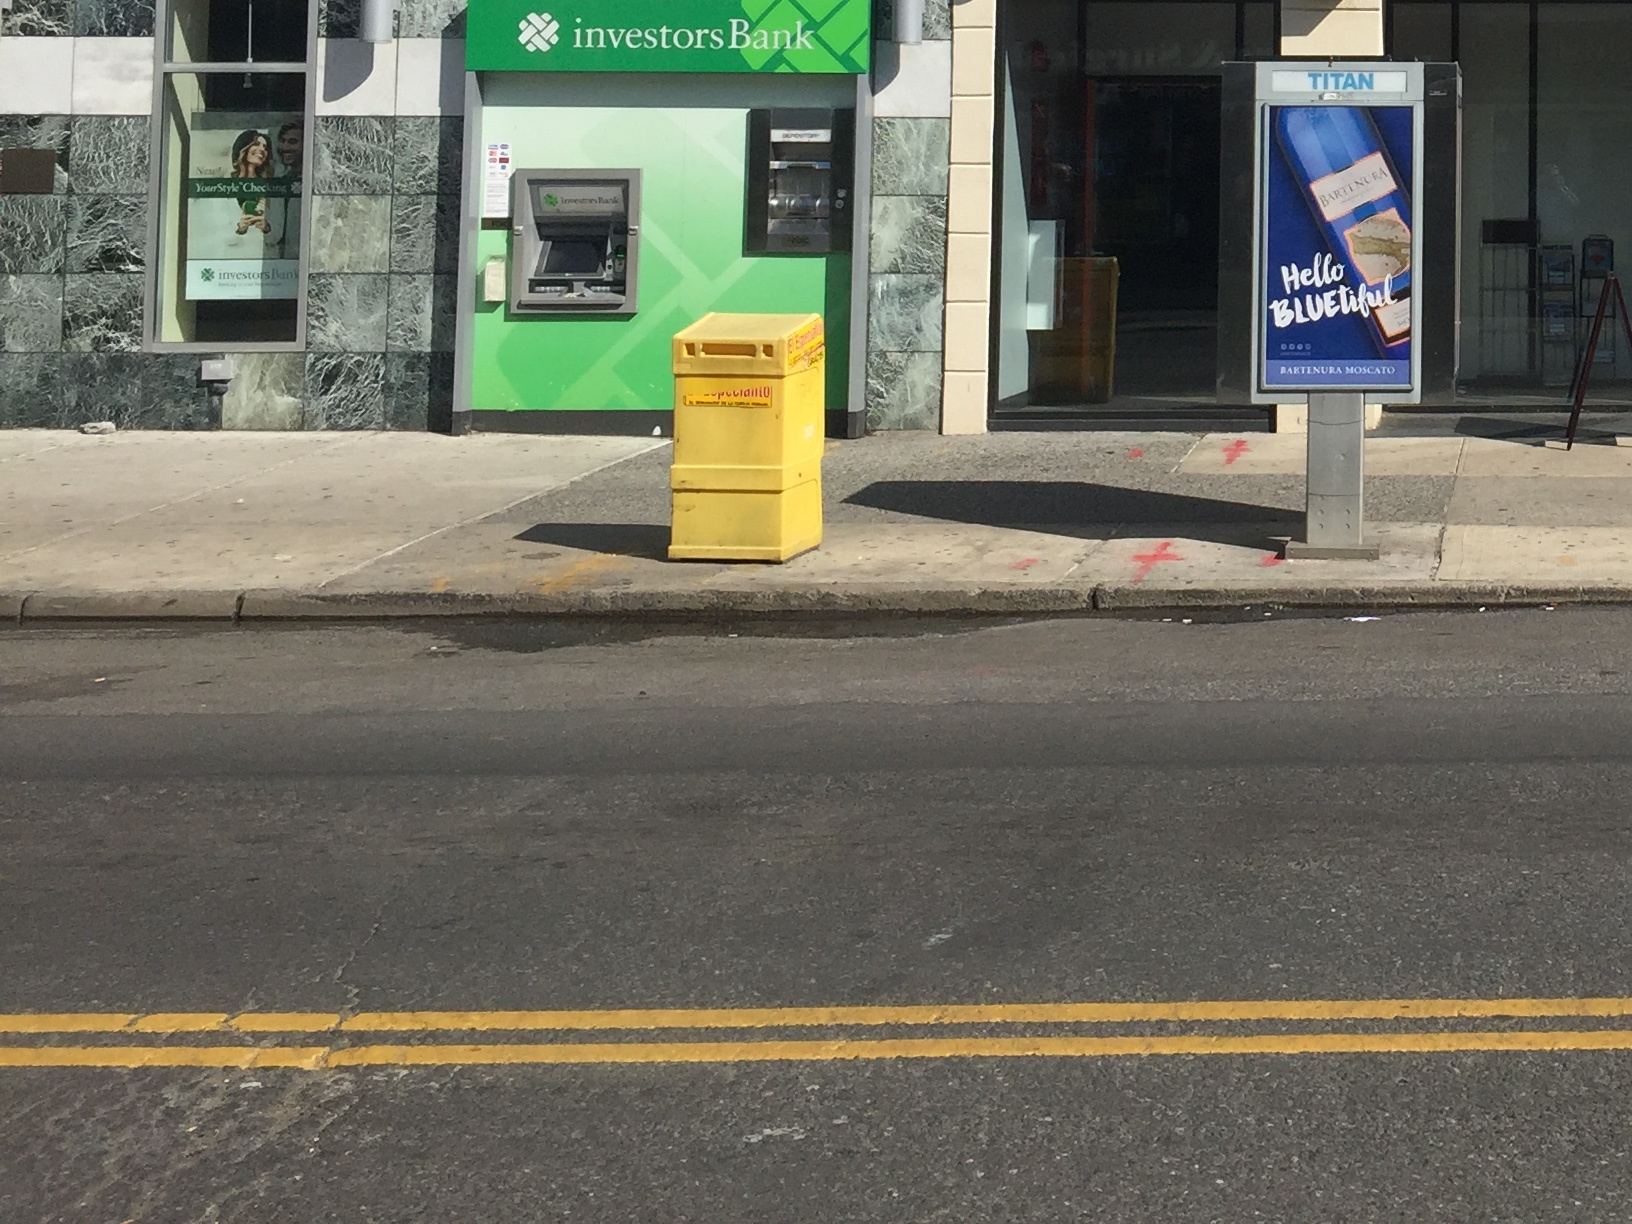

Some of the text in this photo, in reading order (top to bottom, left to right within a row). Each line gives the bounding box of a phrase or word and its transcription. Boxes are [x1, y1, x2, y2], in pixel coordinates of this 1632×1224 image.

[1308, 73, 1374, 90] TITAN
[1319, 167, 1389, 208] BARTENURA
[1281, 252, 1345, 294] Hello
[1280, 366, 1396, 375] BARTENURA MOSCATO
